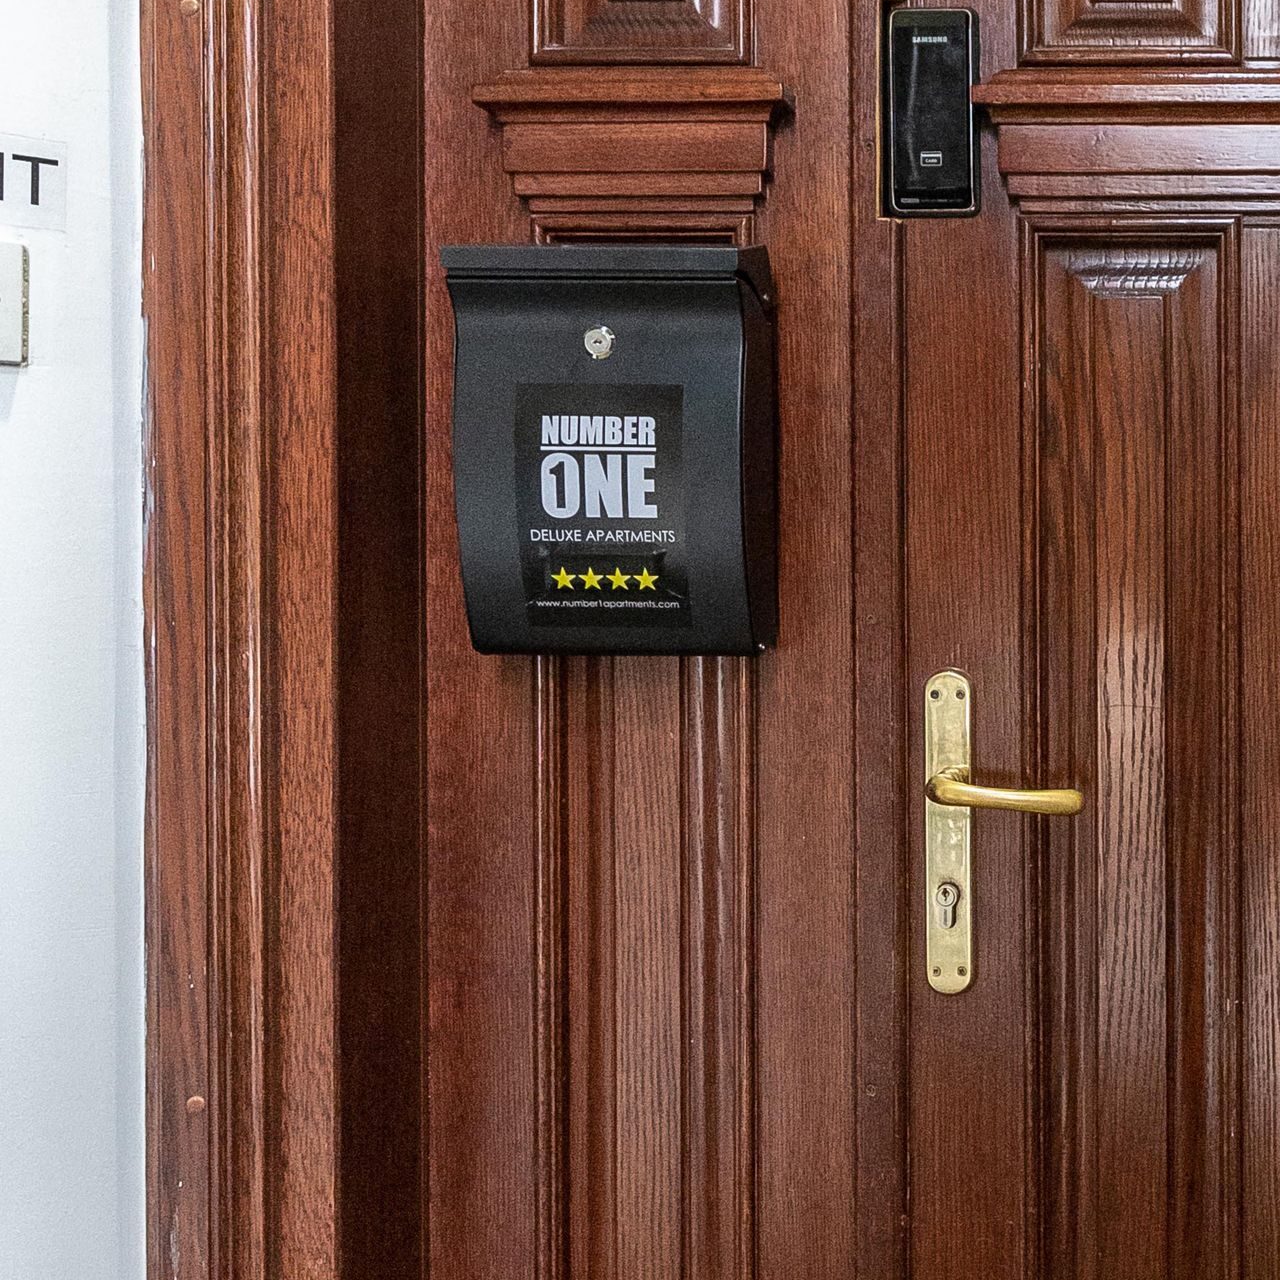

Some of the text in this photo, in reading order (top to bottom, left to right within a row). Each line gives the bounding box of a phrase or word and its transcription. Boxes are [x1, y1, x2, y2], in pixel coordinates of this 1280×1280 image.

[541, 415, 656, 446] NUMBER
[540, 452, 659, 519] ONE
[530, 529, 676, 543] DELUXE APARTMENTS
[536, 599, 680, 609] www.number1apartments.com
